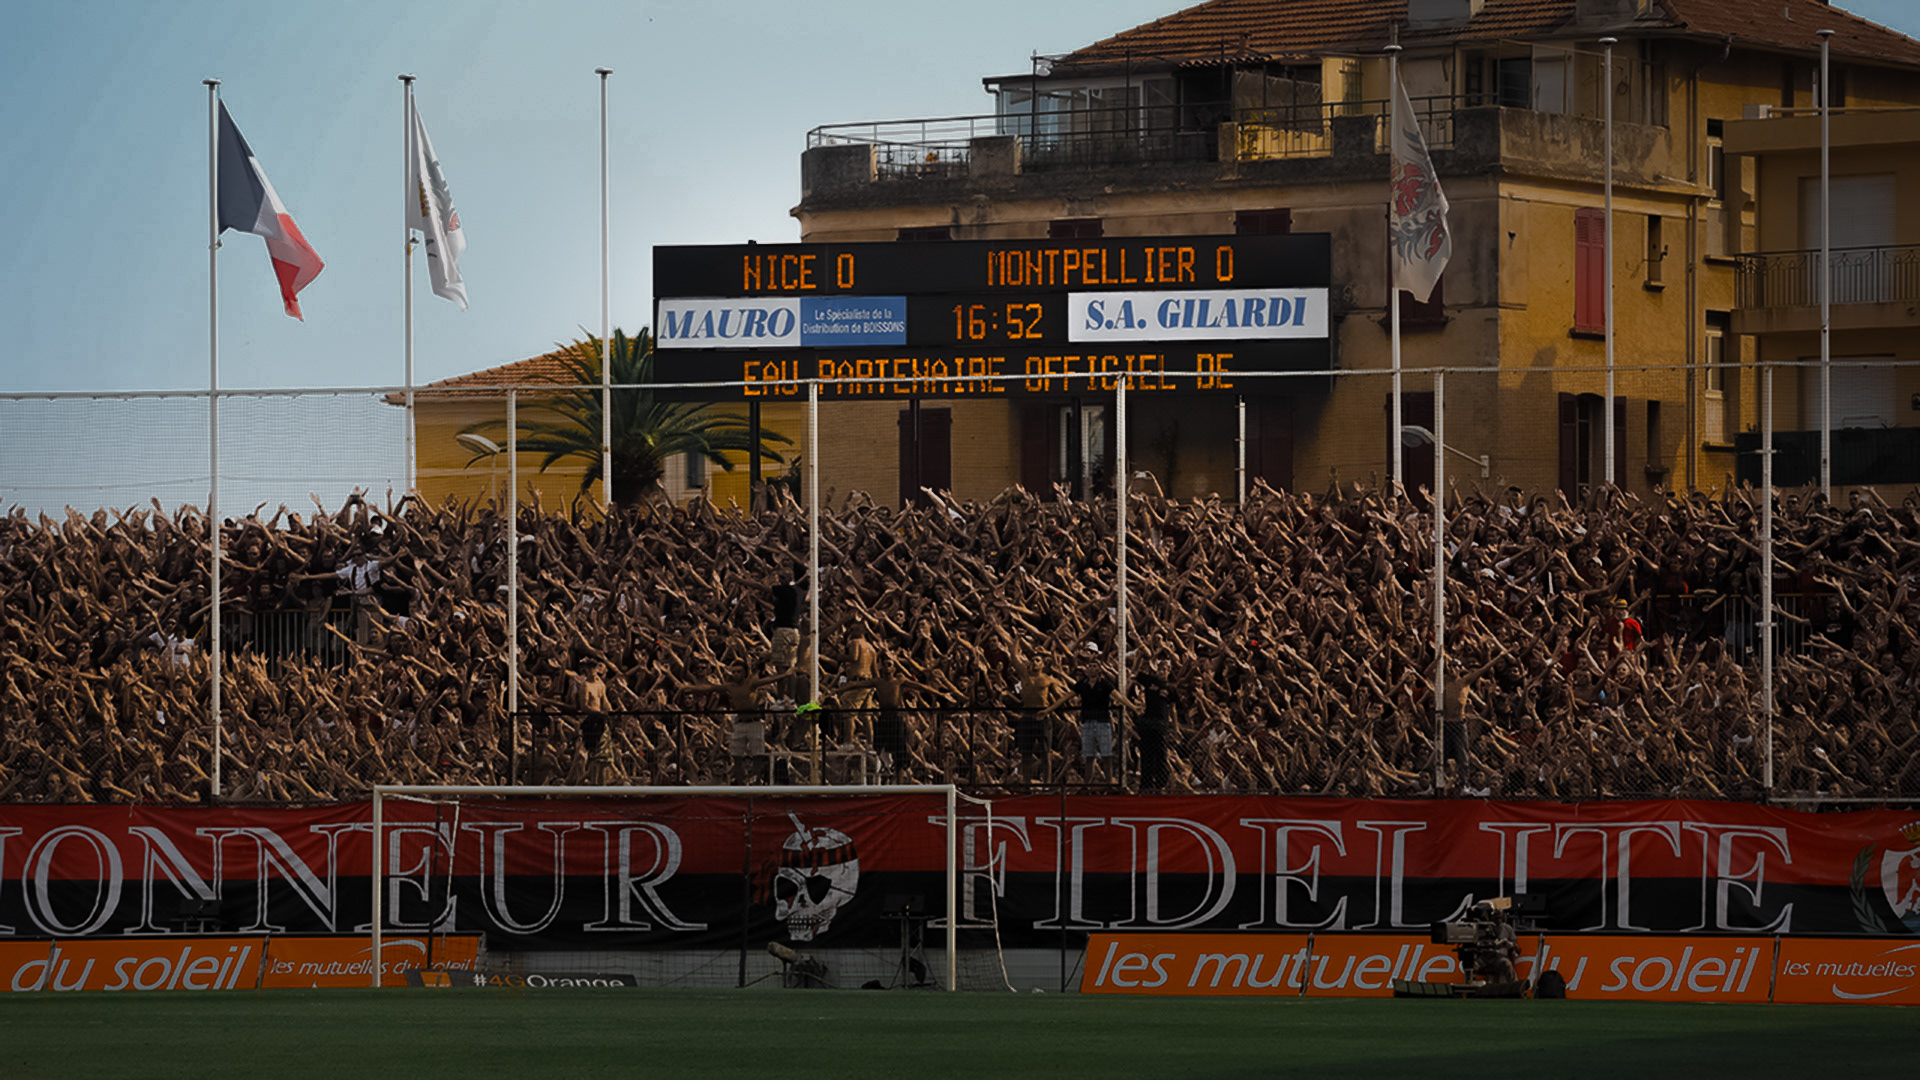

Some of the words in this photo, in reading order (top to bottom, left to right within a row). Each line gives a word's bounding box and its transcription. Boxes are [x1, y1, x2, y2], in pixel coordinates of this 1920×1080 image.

[743, 254, 817, 291] NICE
[987, 246, 1196, 286] MONTPELLIER
[660, 307, 796, 340] MAURO
[803, 322, 850, 334] Distribution
[851, 322, 861, 334] de
[863, 321, 905, 333] BOISSONS
[814, 309, 825, 321] Le
[826, 308, 870, 322] Spécialiste
[872, 308, 883, 320] de
[884, 308, 893, 320] la
[952, 303, 1043, 340] 16:52
[1086, 299, 1147, 330] S.A.
[1157, 297, 1307, 328] GILARDI
[743, 359, 799, 396] EAU
[818, 357, 1006, 395] PARTENAIRE
[1025, 353, 1177, 392] OFFICIEL
[1197, 353, 1235, 390] DE
[0, 821, 709, 937] ONNEUR
[926, 815, 1794, 934] FIDELITE
[11, 947, 96, 992] du
[104, 946, 252, 991] soleil
[270, 958, 295, 974] les
[1094, 941, 1176, 988] les
[1187, 945, 1467, 990] mutuelle
[1600, 946, 1761, 993] soleil
[1783, 959, 1811, 976] les
[1815, 961, 1917, 978] mutuelles
